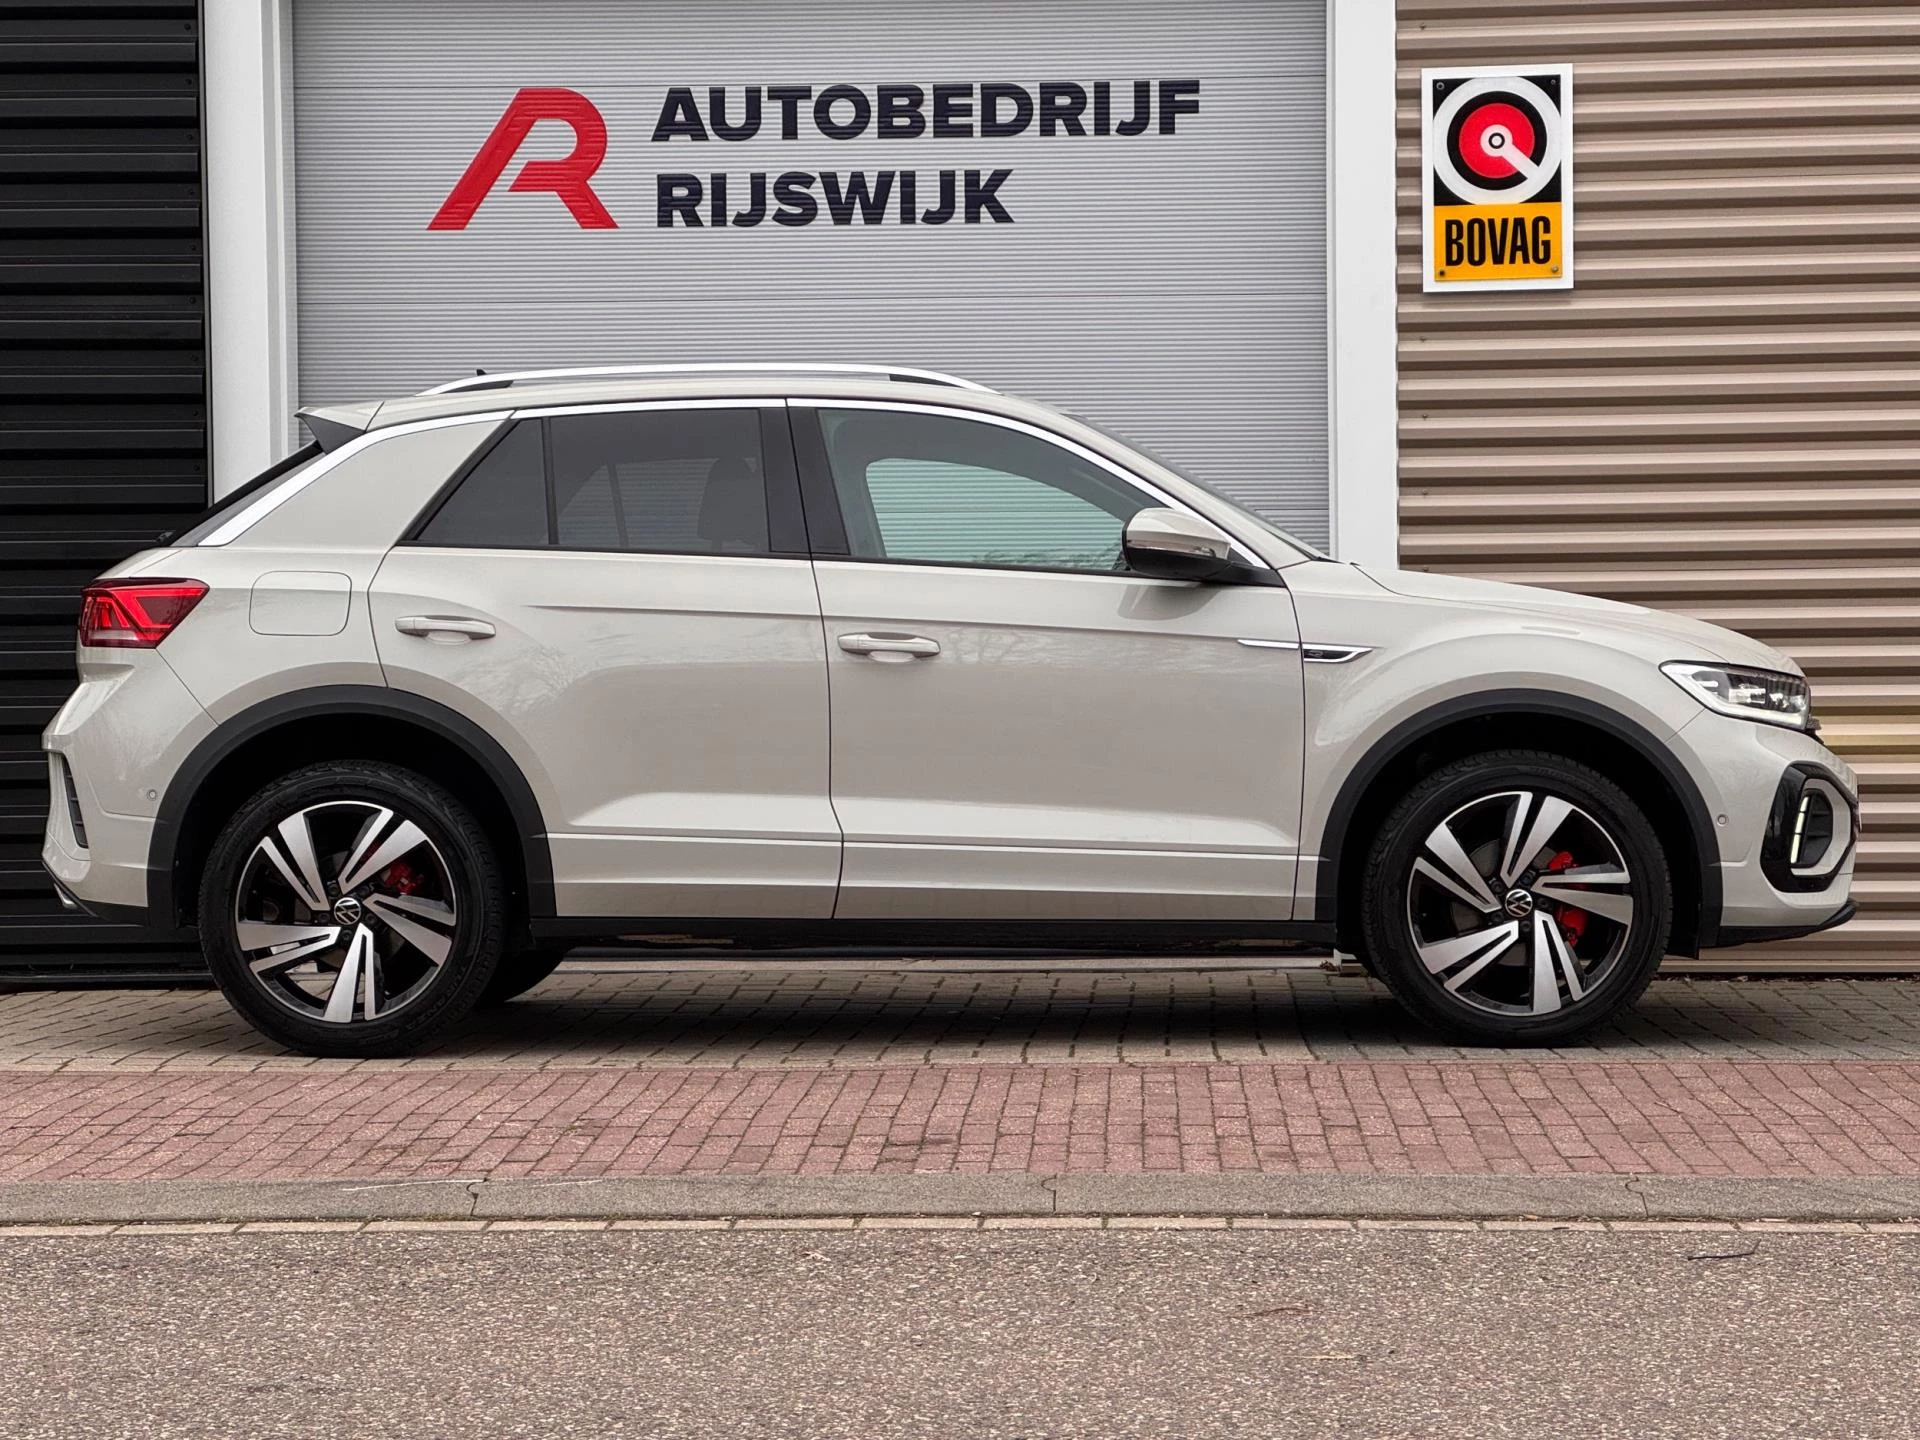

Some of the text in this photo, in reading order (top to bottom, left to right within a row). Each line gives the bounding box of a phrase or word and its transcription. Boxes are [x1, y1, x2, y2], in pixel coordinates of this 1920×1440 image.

[652, 80, 1200, 141] AUTOBEDRIJF
[657, 169, 1014, 228] RIJSWIJK
[1445, 216, 1551, 267] BOVAG
